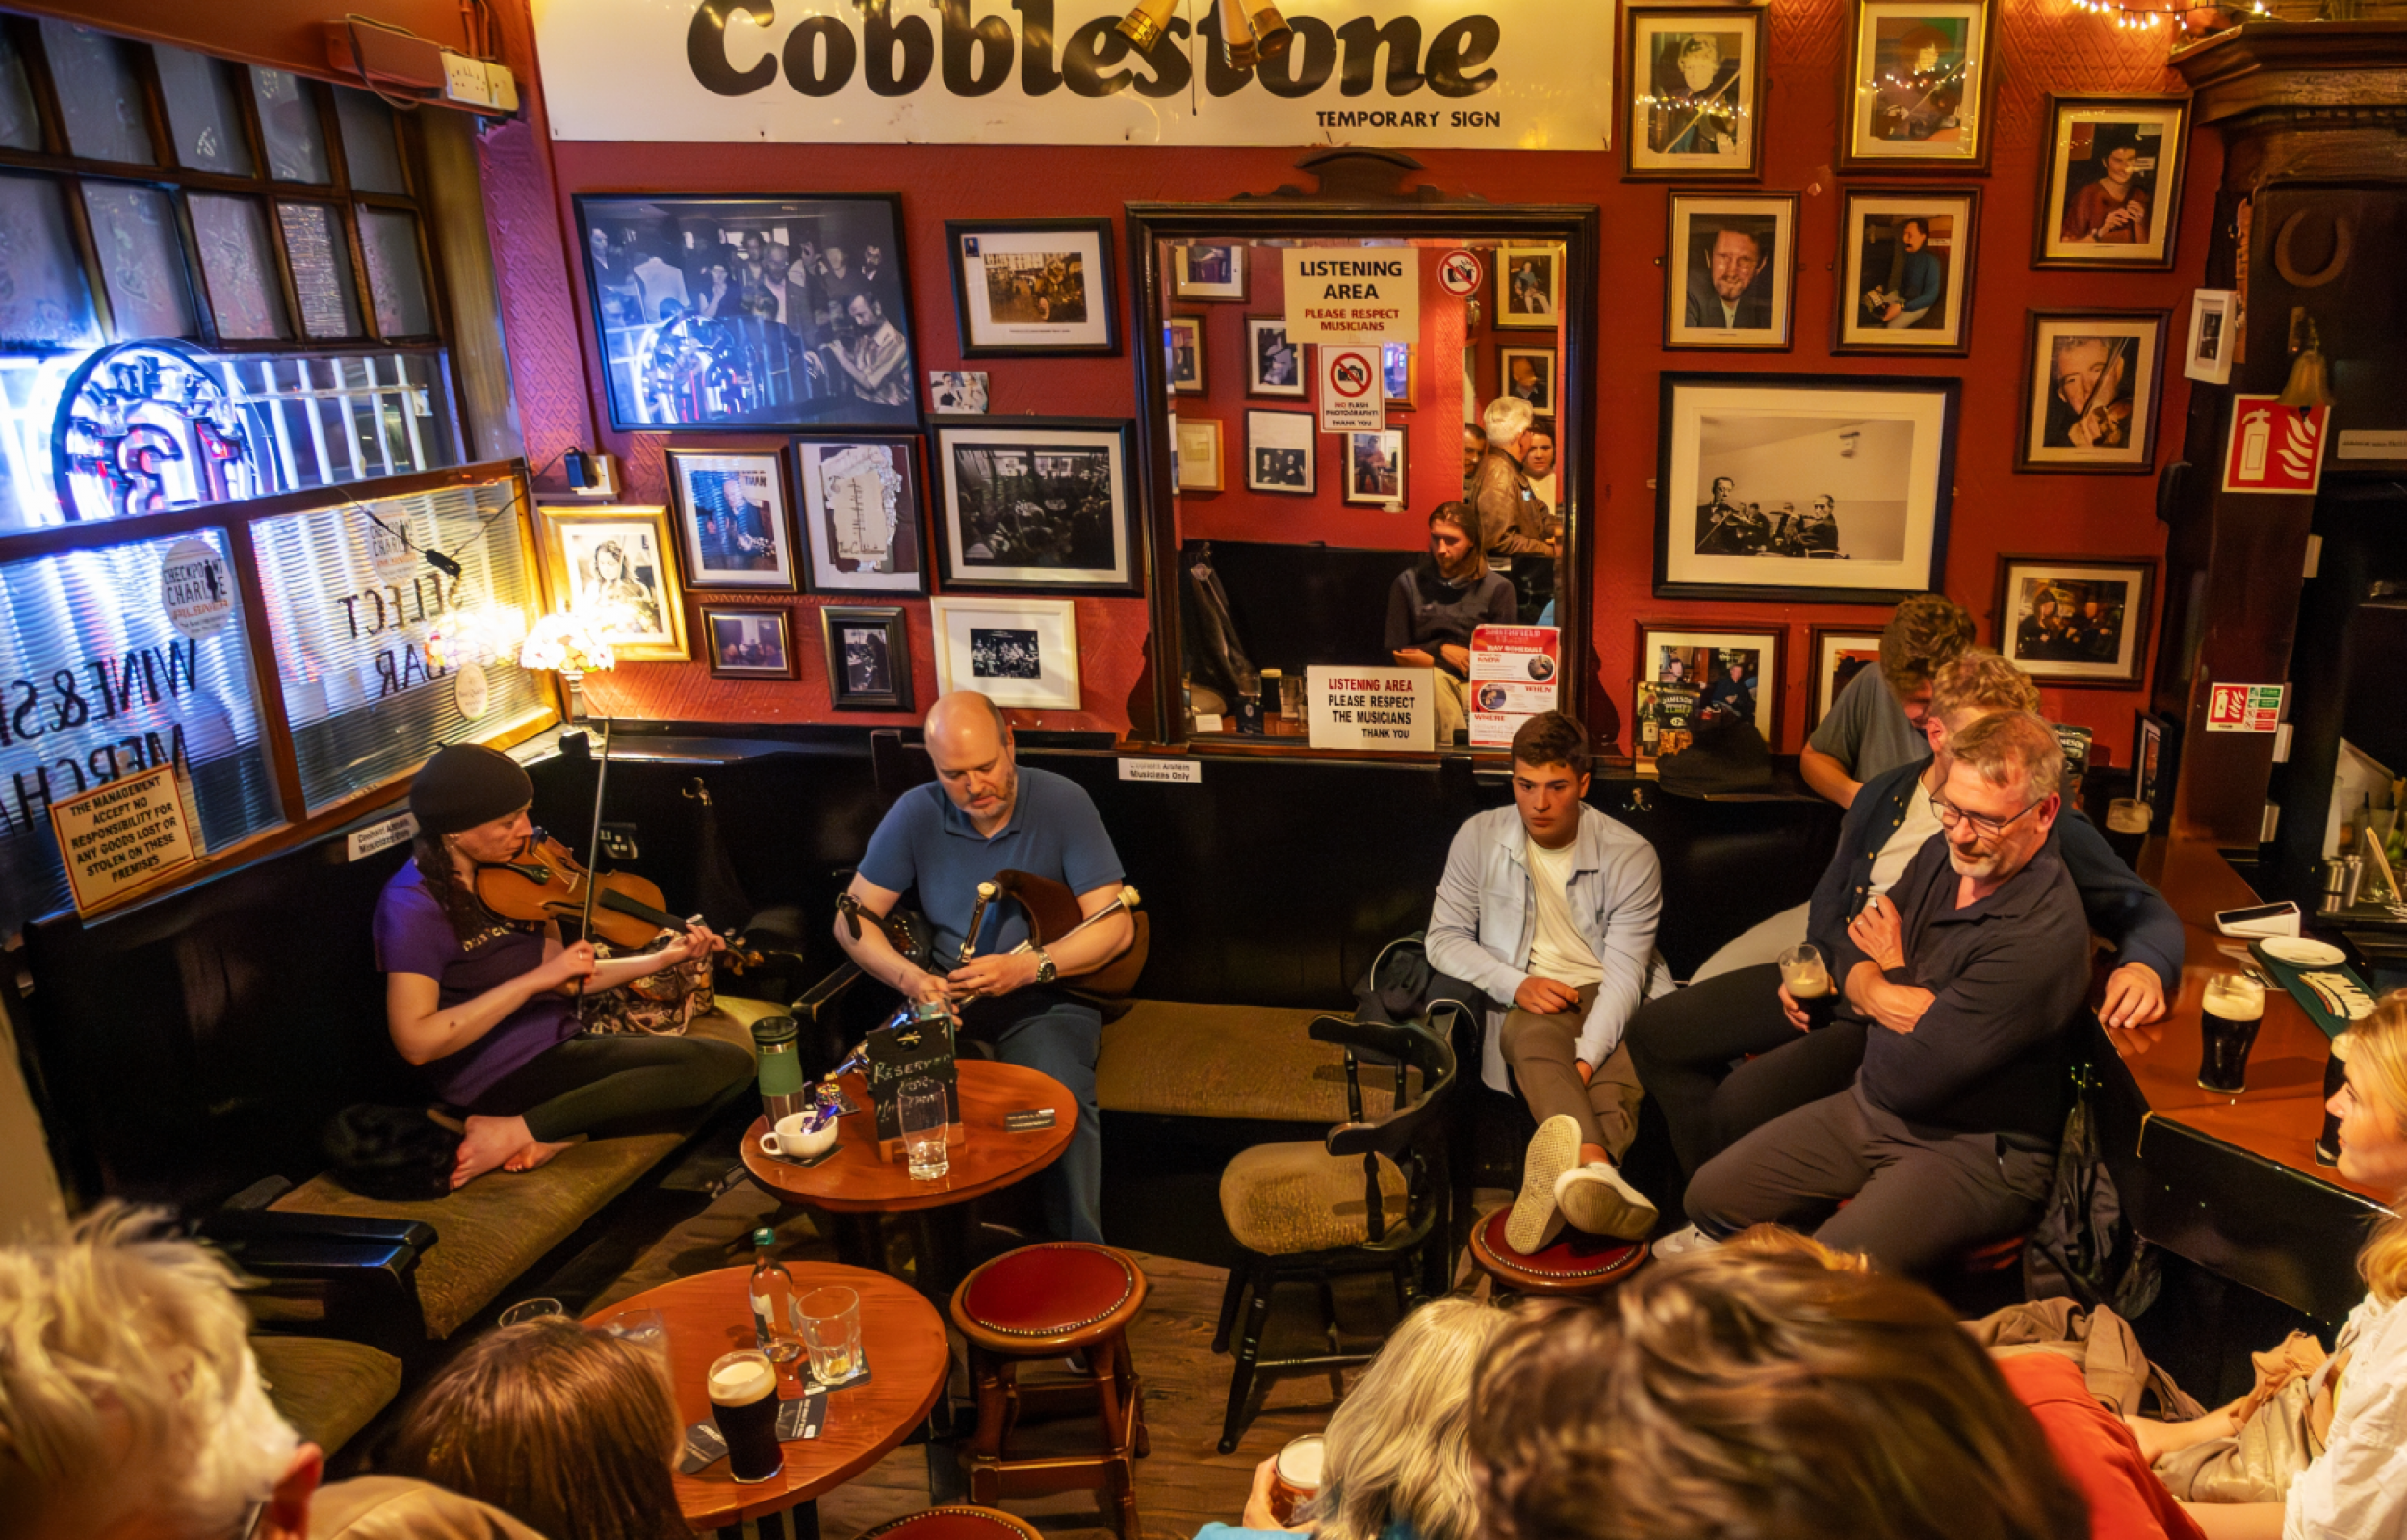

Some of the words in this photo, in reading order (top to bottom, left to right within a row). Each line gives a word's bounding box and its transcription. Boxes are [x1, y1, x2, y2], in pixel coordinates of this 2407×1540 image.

[687, 0, 1500, 97] Cobblestone
[1316, 111, 1440, 127] TEMPORARY
[1451, 111, 1500, 127] SIGN
[1300, 261, 1403, 277] LISTENING
[1323, 284, 1379, 299] AREA
[1305, 309, 1346, 319] PLEASE
[1351, 309, 1400, 319] RESPECT
[1321, 321, 1385, 331] MUSICIANS
[1329, 678, 1381, 691] LISTENING
[1385, 680, 1413, 692] AREA
[1329, 694, 1365, 707] PLEASE
[1370, 696, 1415, 709] RESPECT
[1333, 710, 1352, 723] THE
[1357, 711, 1411, 725] MUSICIANS
[1361, 728, 1390, 739] THANK
[1392, 729, 1410, 739] YOU
[1172, 772, 1190, 782] Only
[69, 802, 92, 817] THE
[92, 776, 161, 808] MANAGEMENT
[93, 802, 131, 826] ACCEPT
[133, 797, 148, 809] NO
[71, 810, 152, 849] RESPONSIBILITY
[154, 802, 174, 817] FOR
[77, 846, 97, 865] ANY
[99, 833, 136, 854] GOODS
[137, 822, 161, 840] LOST
[163, 816, 177, 829] OR
[87, 853, 127, 877] STOLEN
[128, 845, 143, 859] ON
[144, 833, 175, 853] THESE
[111, 854, 160, 883] PREMISES
